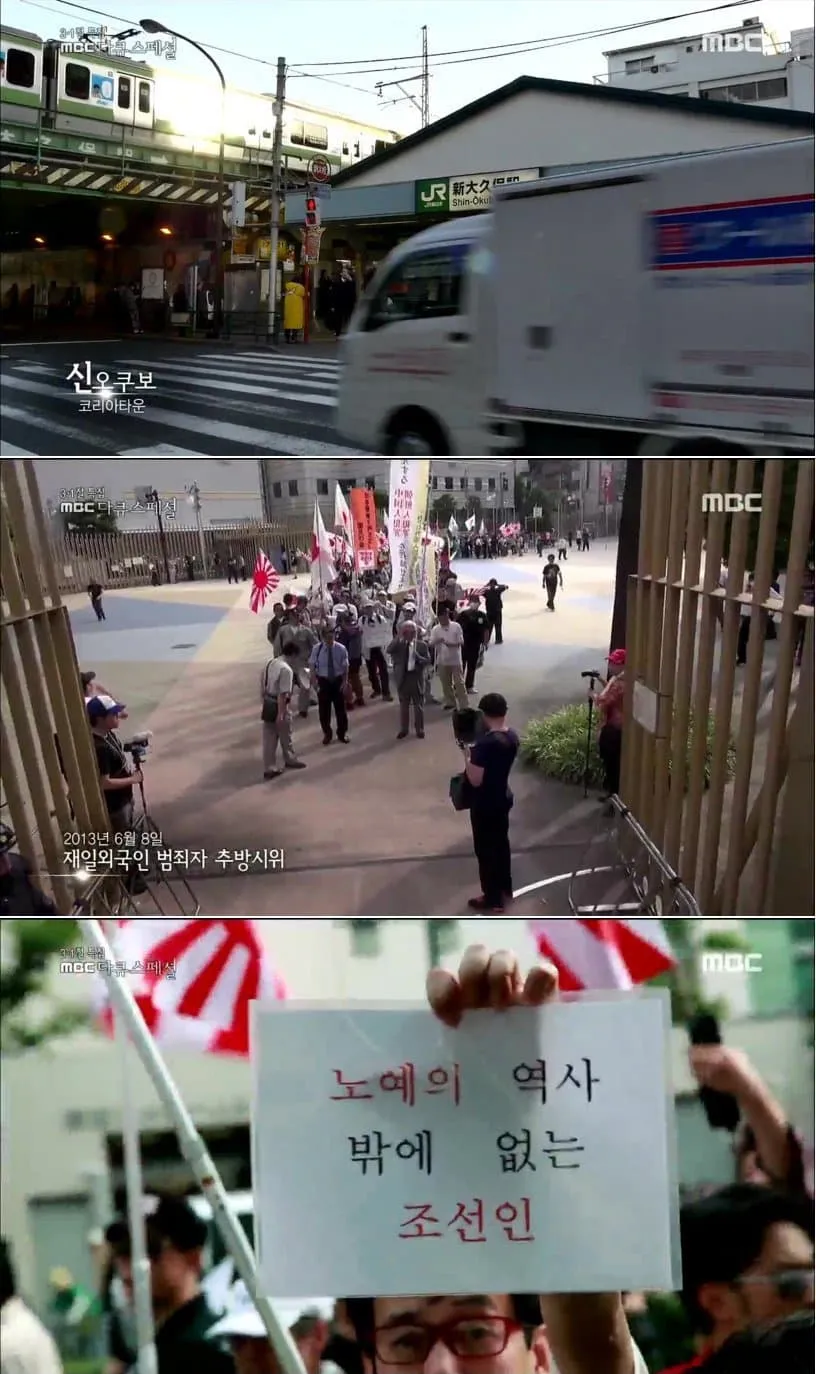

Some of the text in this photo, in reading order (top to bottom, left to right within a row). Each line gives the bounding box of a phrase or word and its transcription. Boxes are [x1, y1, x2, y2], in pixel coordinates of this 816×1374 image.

[421, 184, 447, 201] JR
[330, 1057, 601, 1107] 노예의 역사
[348, 1128, 585, 1176] 밖에 없는
[398, 1197, 536, 1243] 조선인
